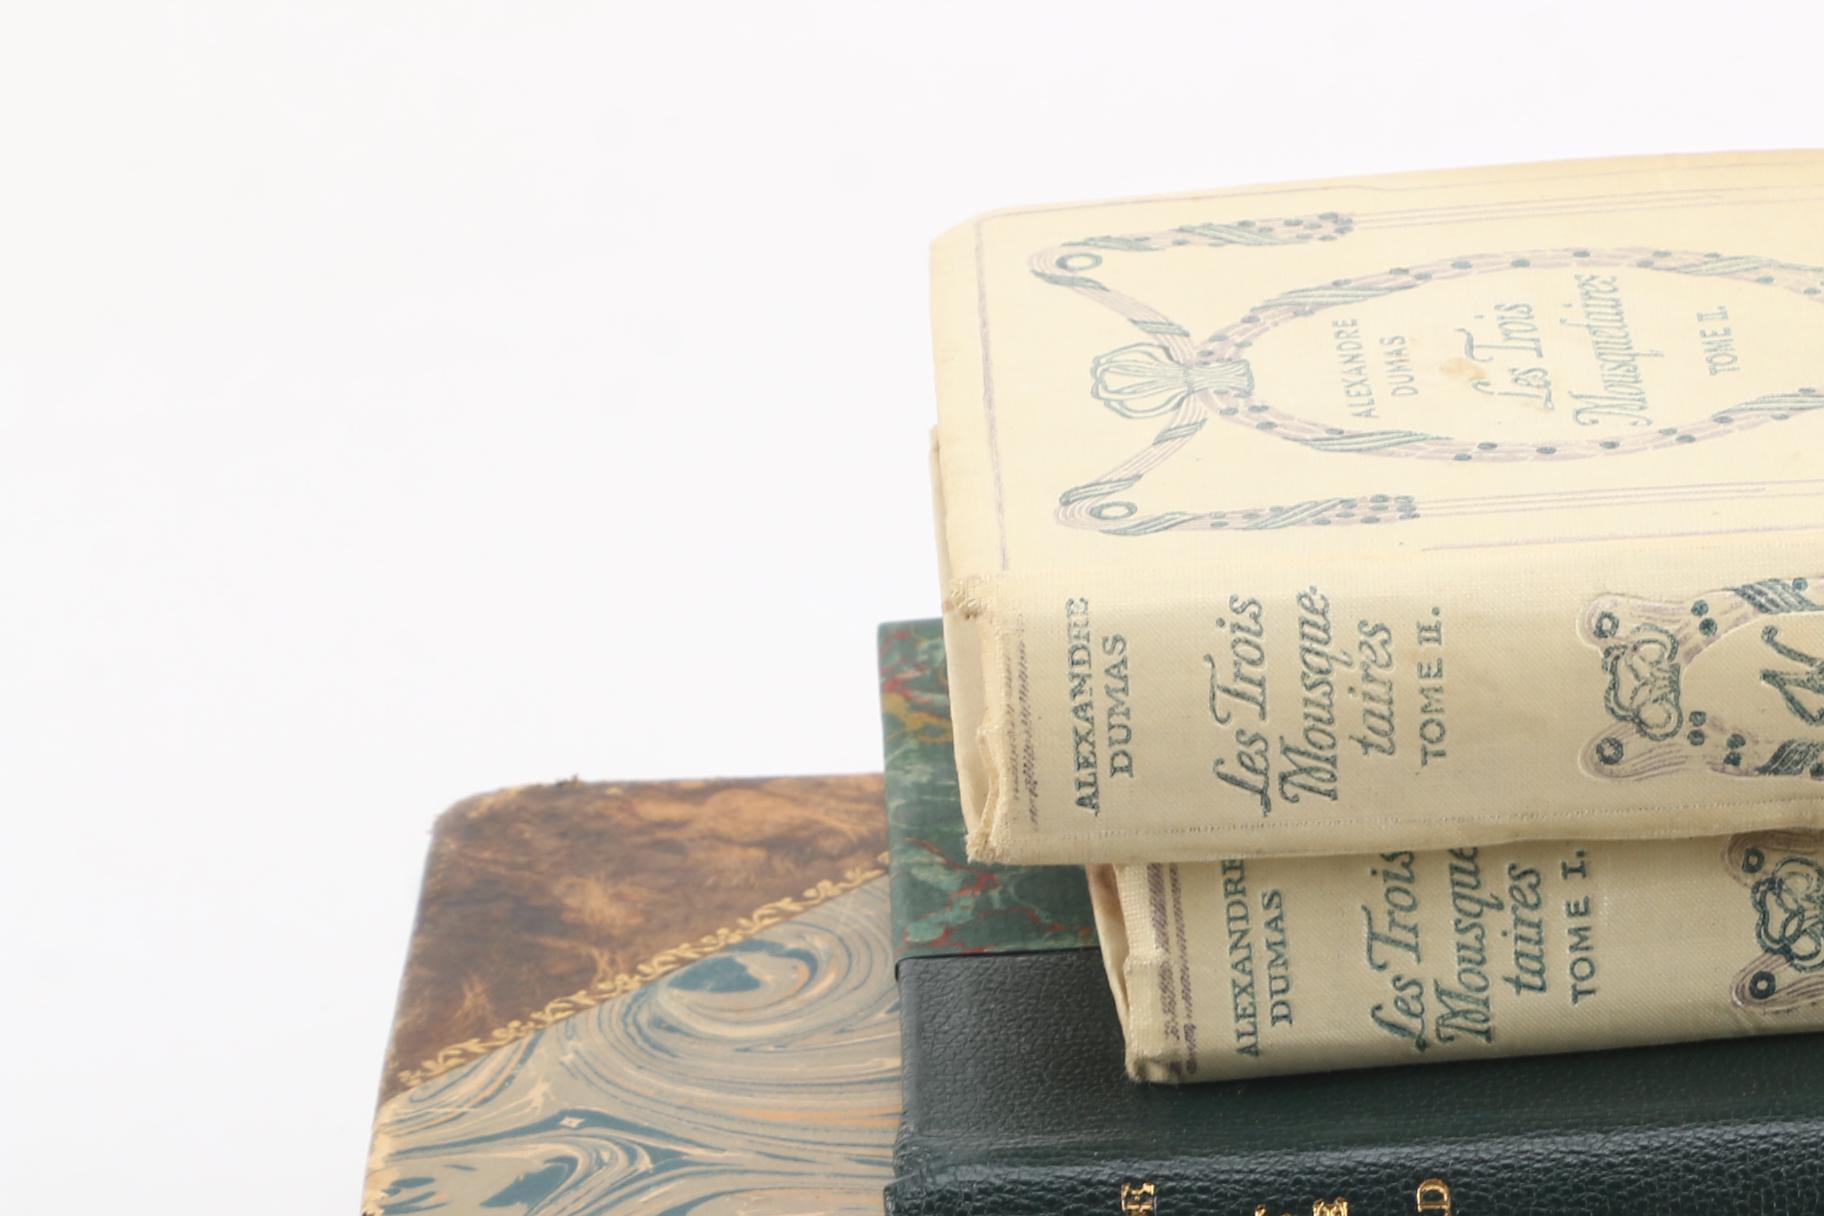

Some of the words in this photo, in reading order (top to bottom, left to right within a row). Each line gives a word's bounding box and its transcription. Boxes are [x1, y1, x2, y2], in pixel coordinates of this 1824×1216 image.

[1332, 318, 1379, 420] ALEXANDRE
[1380, 335, 1419, 397] DUMAS
[1456, 303, 1544, 363] Trois
[1472, 366, 1554, 410] Les
[1560, 274, 1665, 426] Mousquetaires
[1700, 328, 1740, 376] TOME
[1066, 596, 1100, 816] ALEXANDRE
[1102, 633, 1134, 779] DUMAS
[1202, 593, 1267, 725] Trois
[1348, 619, 1396, 757] taires
[1417, 657, 1447, 767] TOME
[1212, 727, 1272, 817] Les
[1221, 858, 1260, 1057] ALEXANDRE
[1261, 888, 1293, 1027] DUMAS
[1361, 850, 1420, 972] Trois
[1502, 862, 1548, 996] taires
[1566, 895, 1597, 1005] TOME
[1371, 974, 1428, 1052] Les
